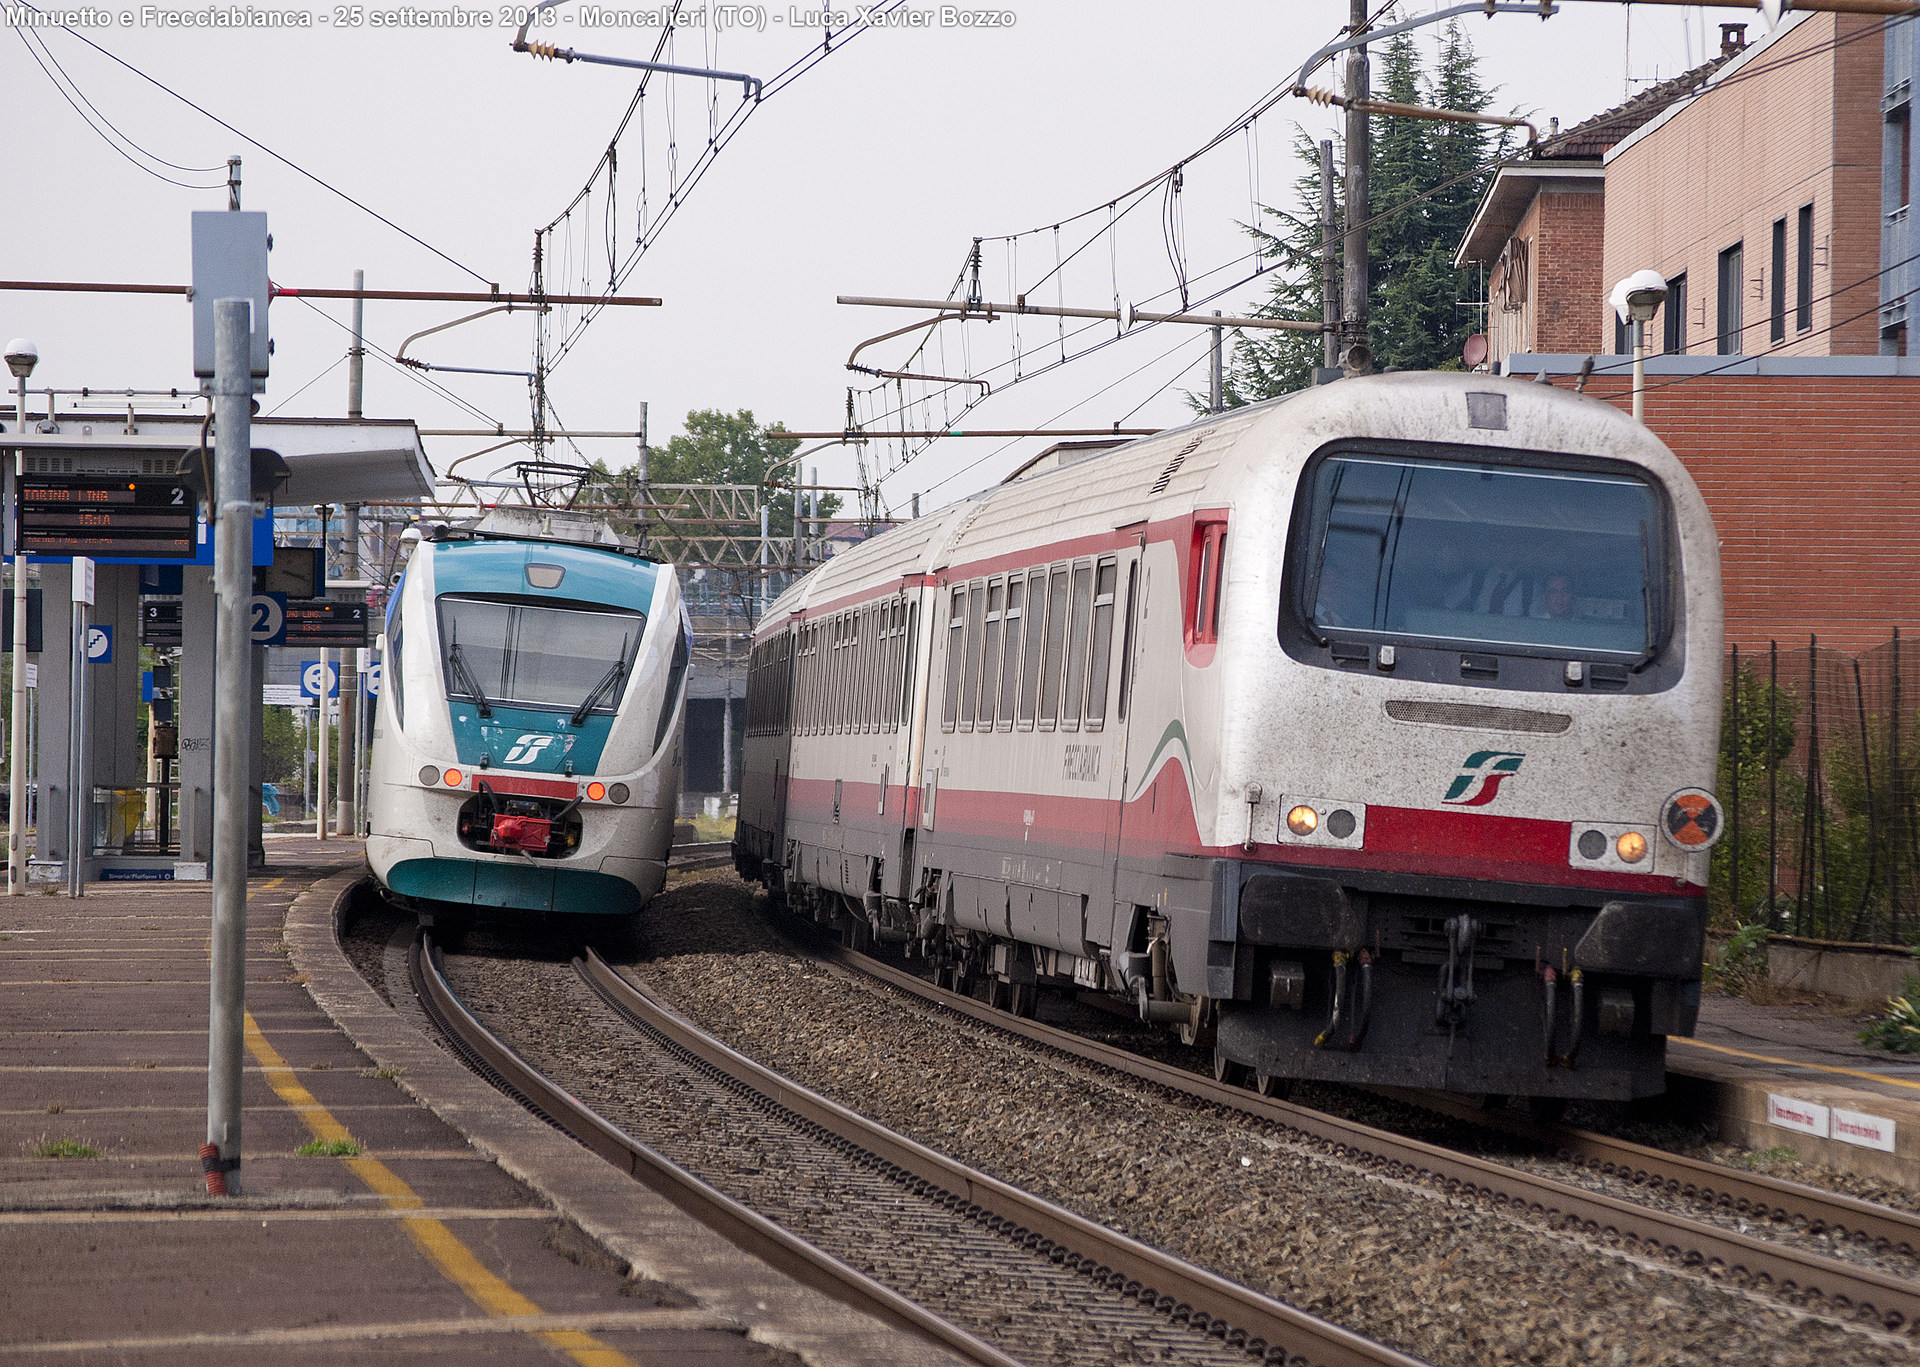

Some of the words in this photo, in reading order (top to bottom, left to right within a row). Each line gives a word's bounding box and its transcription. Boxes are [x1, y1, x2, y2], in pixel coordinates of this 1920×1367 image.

[171, 487, 184, 505] 2
[150, 607, 157, 617] 3
[251, 603, 270, 632] 2
[353, 609, 360, 619] 2
